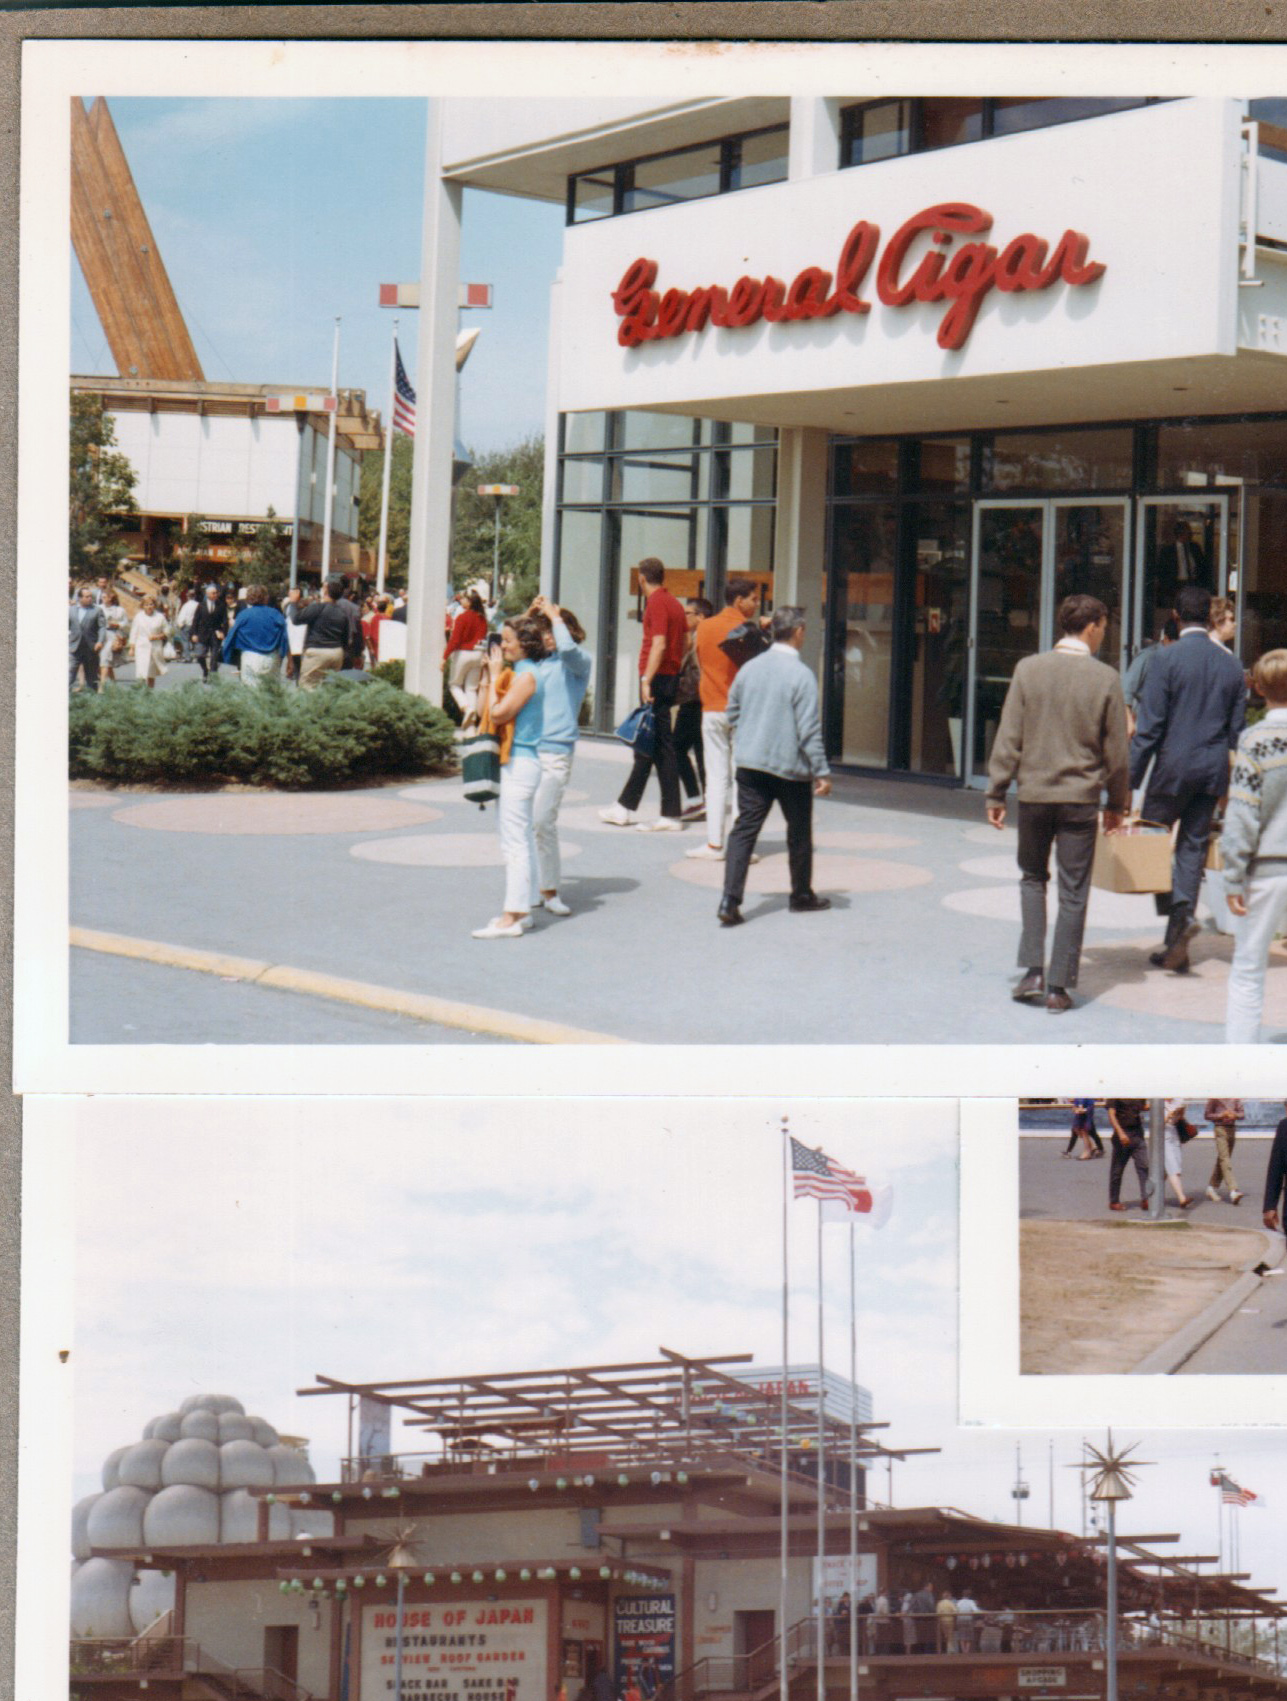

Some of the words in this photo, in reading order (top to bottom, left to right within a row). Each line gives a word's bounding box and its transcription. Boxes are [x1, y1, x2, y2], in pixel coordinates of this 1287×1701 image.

[611, 220, 881, 347] General
[877, 202, 1107, 350] Cigar
[616, 1600, 675, 1615] CULTURAL
[443, 1610, 466, 1627] OF
[475, 1607, 534, 1625] JAPAN
[616, 1618, 675, 1634] TREASURE
[381, 1653, 431, 1664] SKVIEW
[440, 1652, 471, 1664] ROOF
[476, 1651, 525, 1662] GARDEN
[426, 1678, 448, 1688] BAR
[463, 1677, 492, 1688] SAKE
[497, 1676, 519, 1687] BR
[467, 1691, 505, 1701] HOUSE
